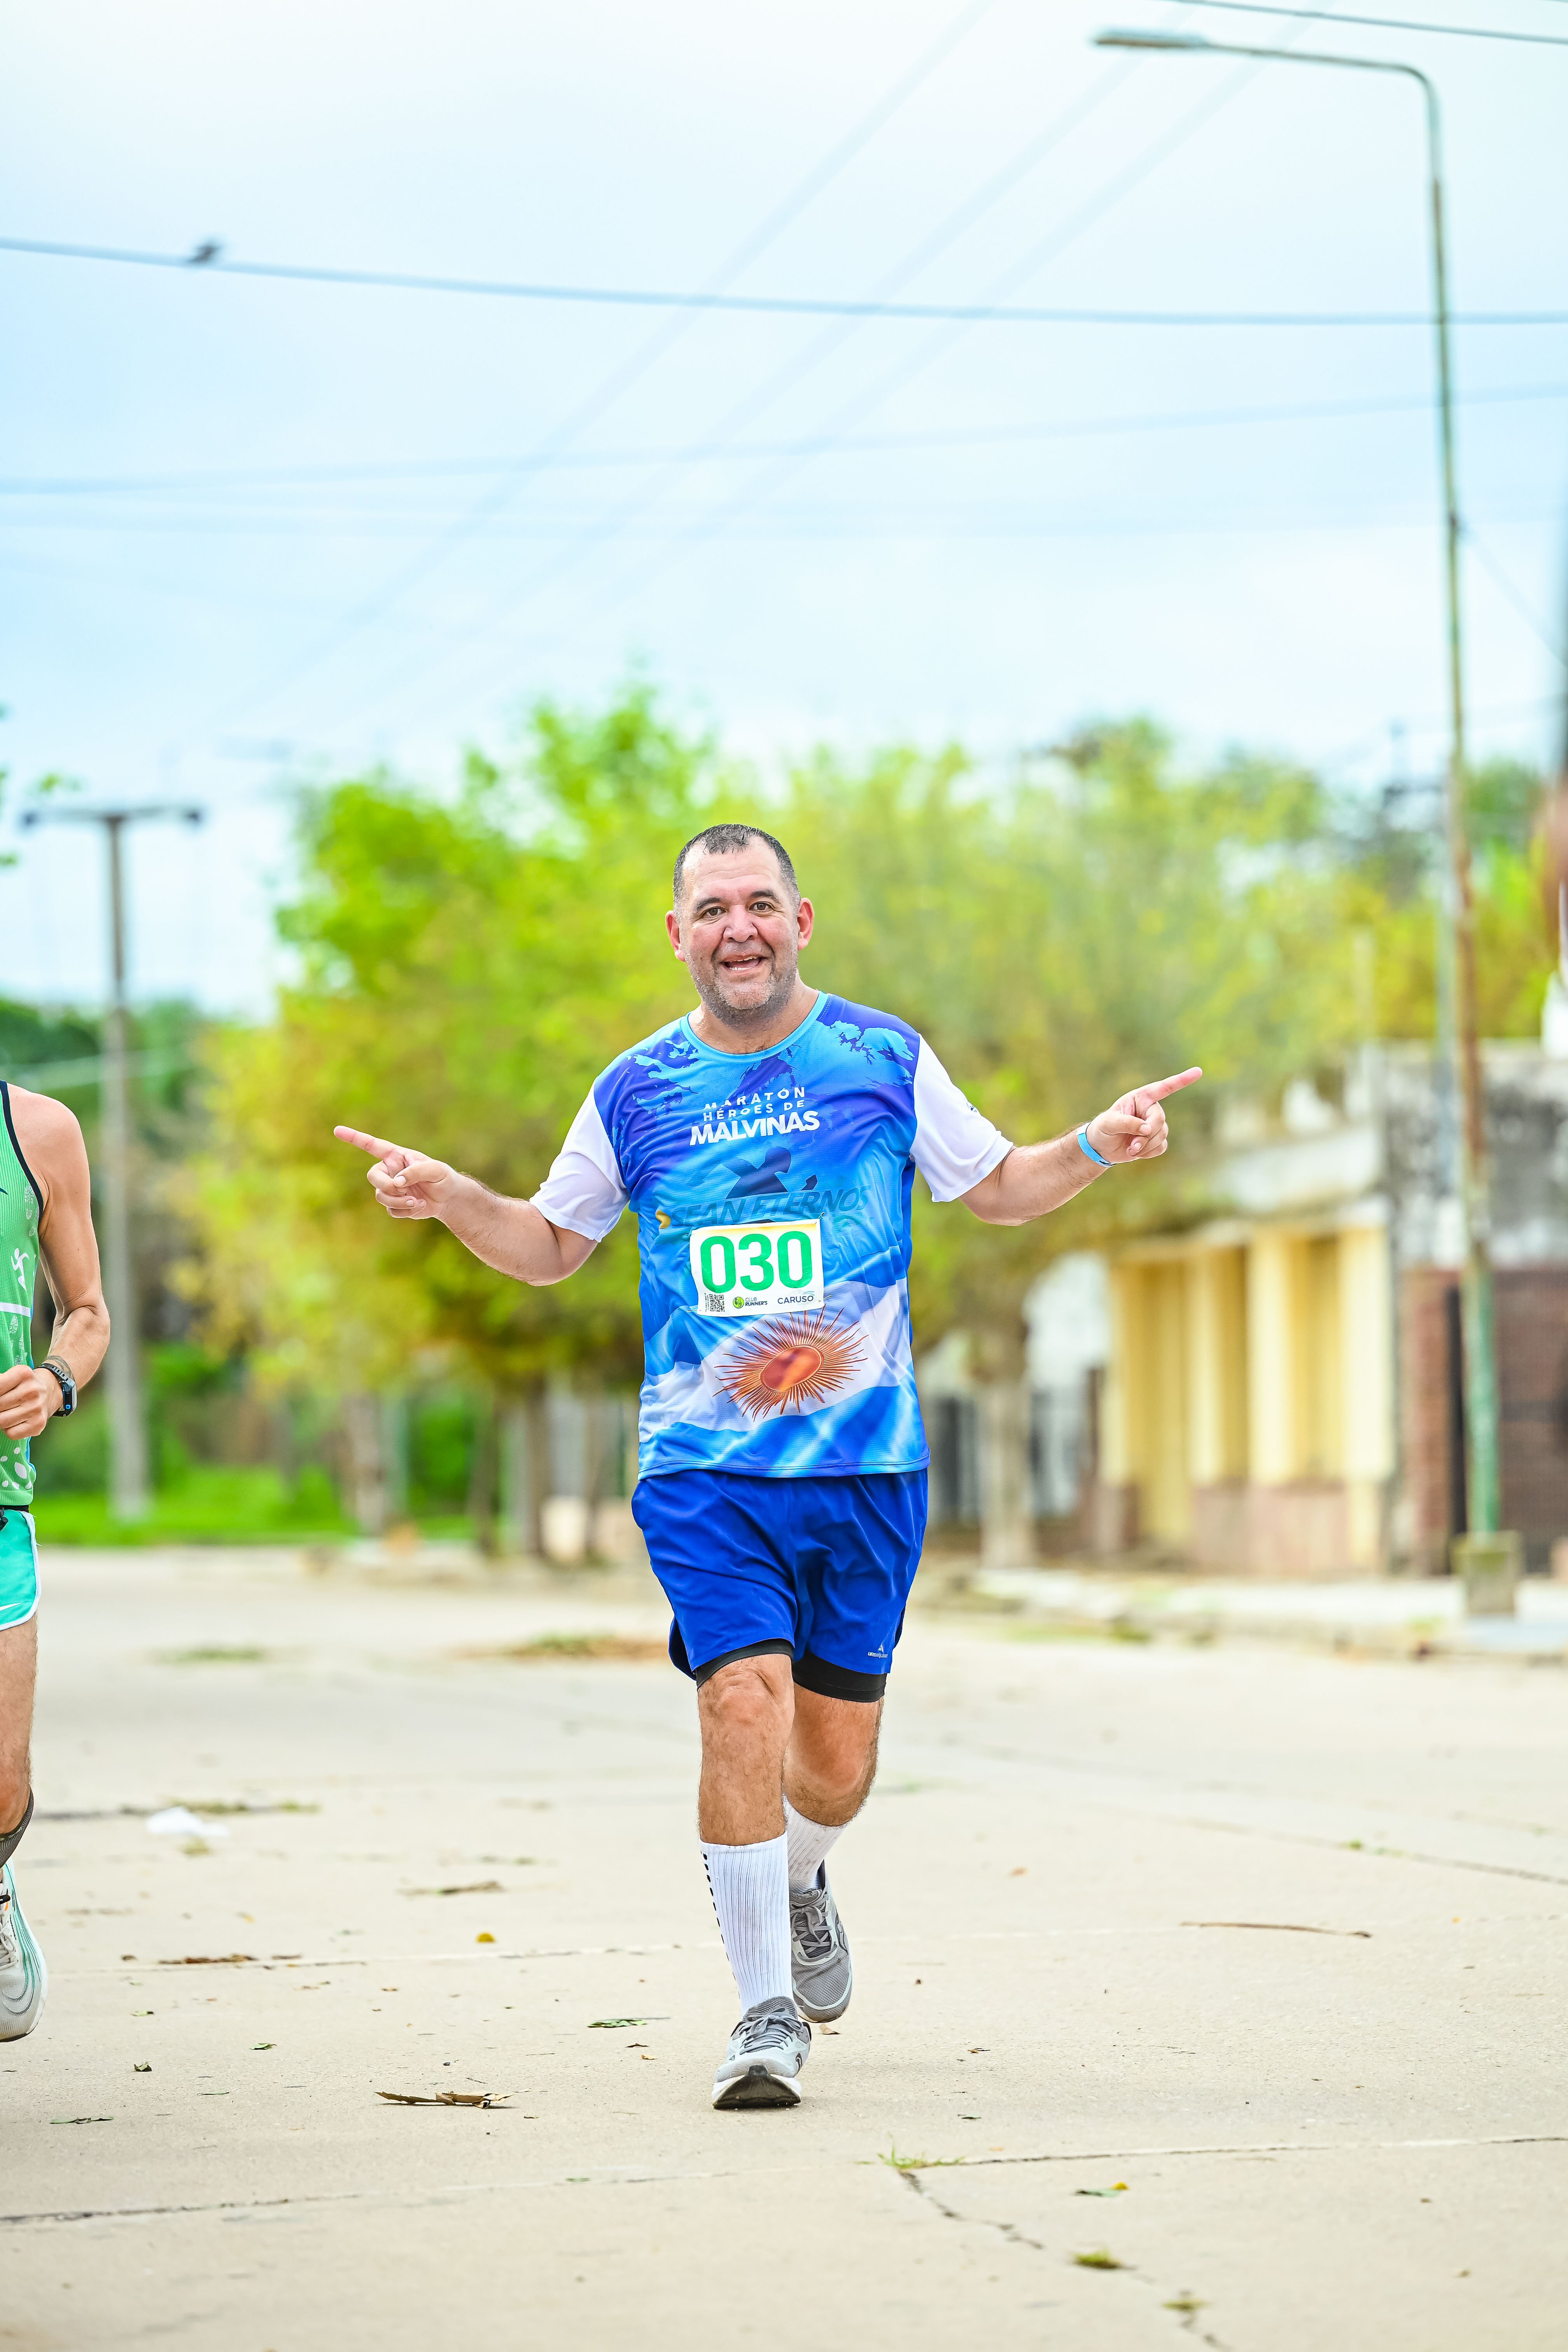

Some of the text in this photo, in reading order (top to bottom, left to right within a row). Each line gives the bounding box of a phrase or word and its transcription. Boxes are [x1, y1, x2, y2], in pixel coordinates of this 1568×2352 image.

[703, 1087, 805, 1110] MARATÓN
[703, 1100, 804, 1122] HÉROES DE
[690, 1110, 820, 1146] MALVINAS
[672, 1186, 869, 1227] SEAN ETERNOS
[700, 1231, 812, 1293] 030
[777, 1295, 814, 1304] CARUSO
